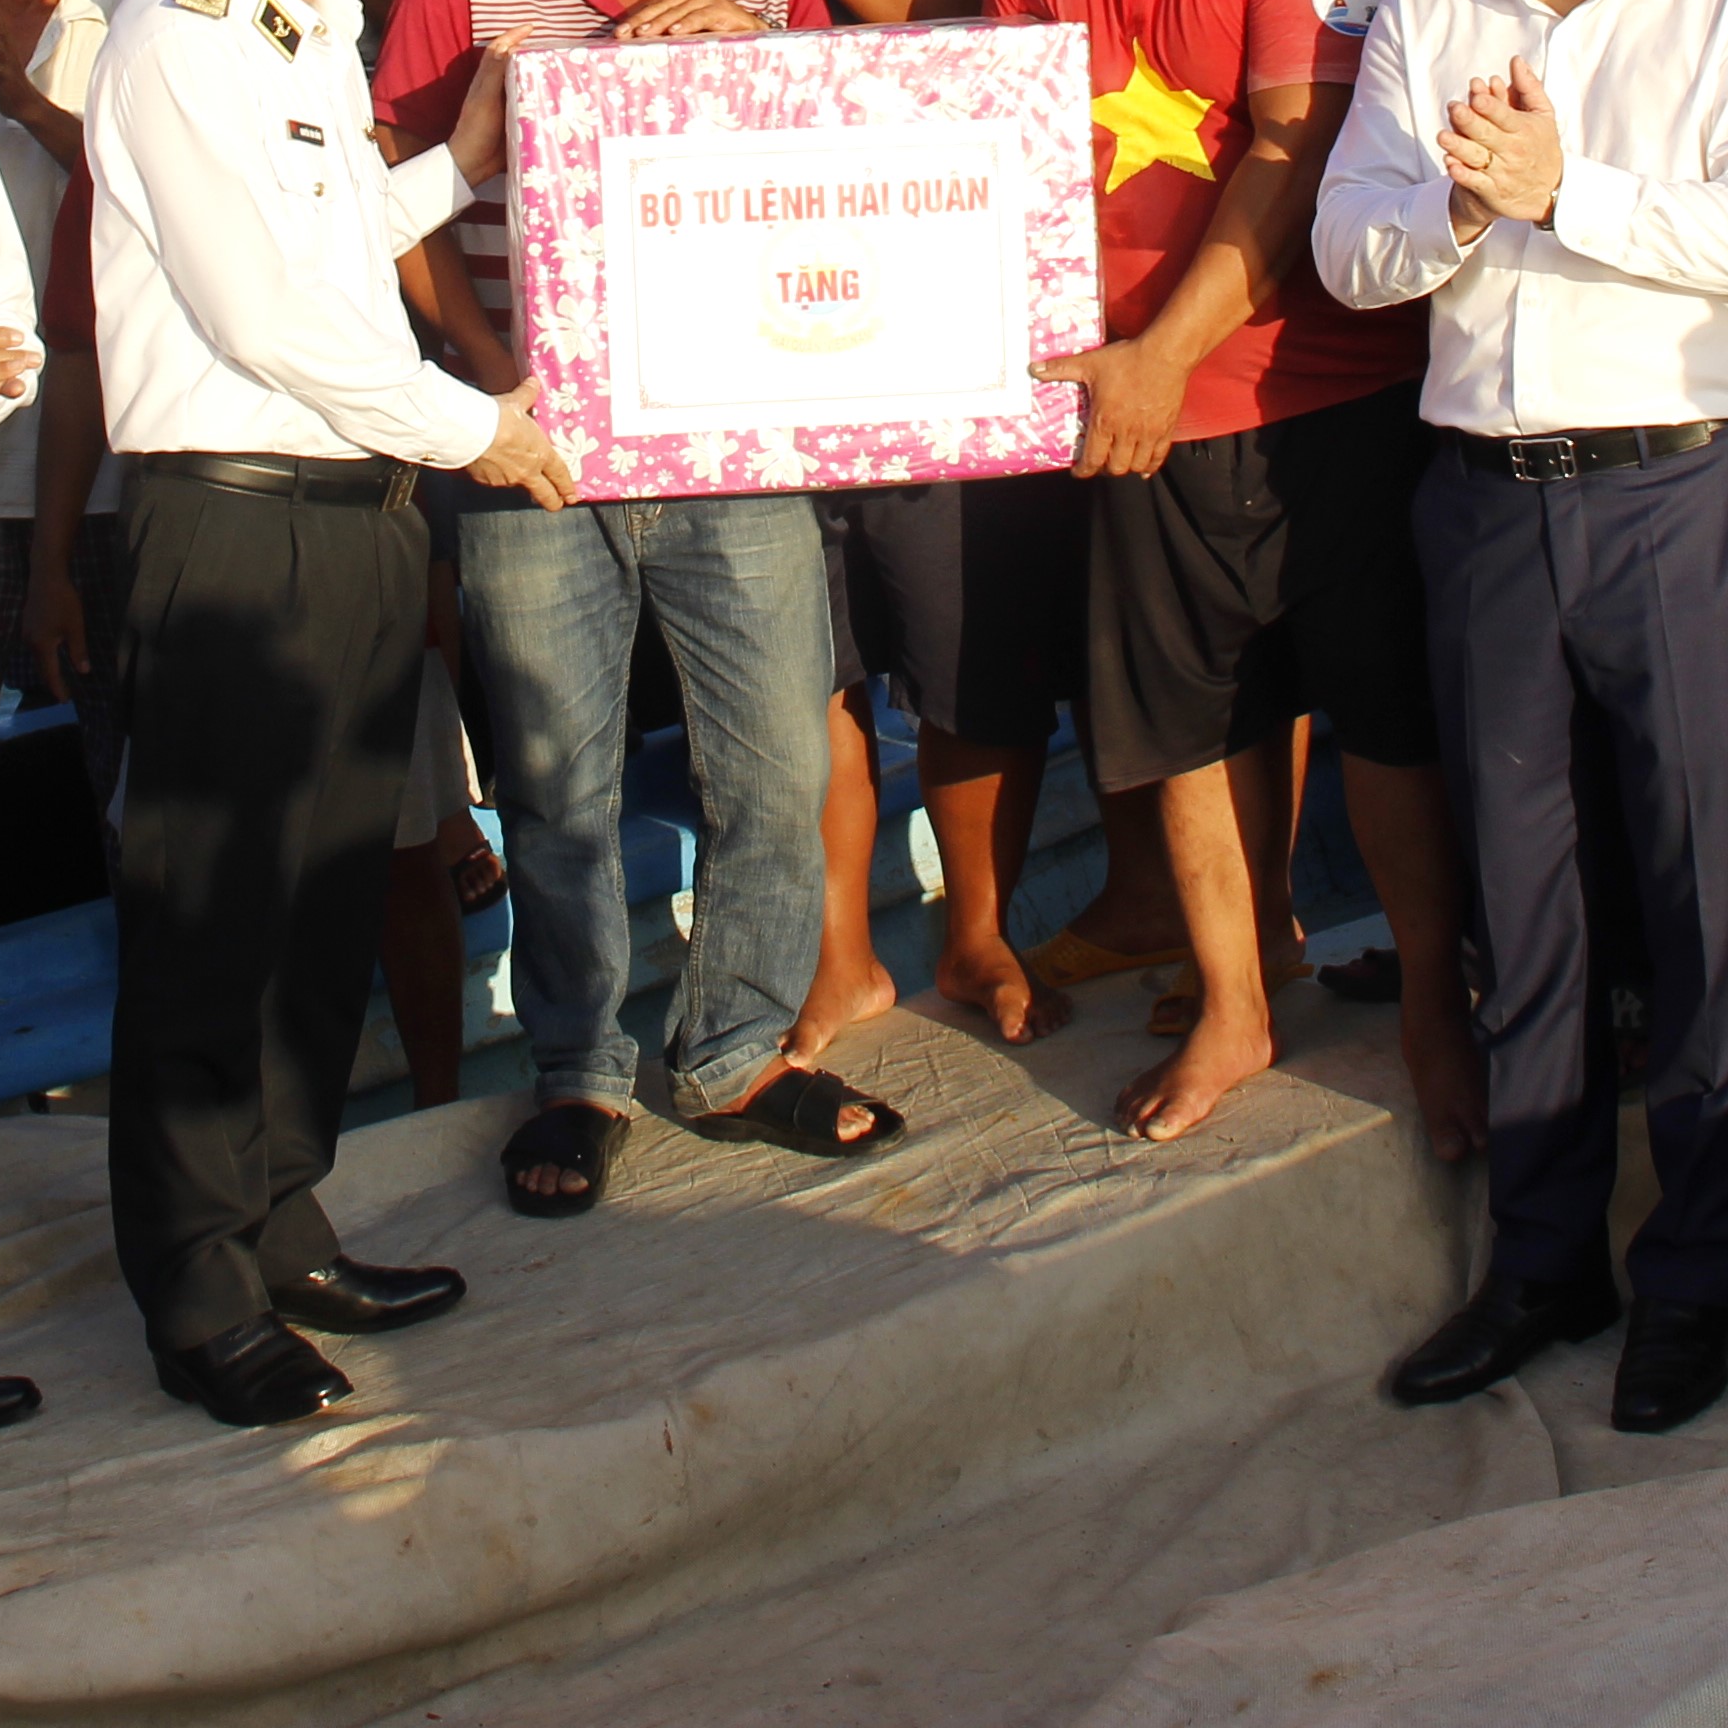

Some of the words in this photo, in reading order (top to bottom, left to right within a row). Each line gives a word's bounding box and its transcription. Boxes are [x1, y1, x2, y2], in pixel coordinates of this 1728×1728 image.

[640, 184, 683, 235] BỘ
[693, 185, 735, 225] TƯ
[743, 179, 826, 229] LỆNH
[837, 167, 890, 219] HẢI
[902, 170, 989, 219] QUÂN
[776, 264, 860, 311] TẶNG
